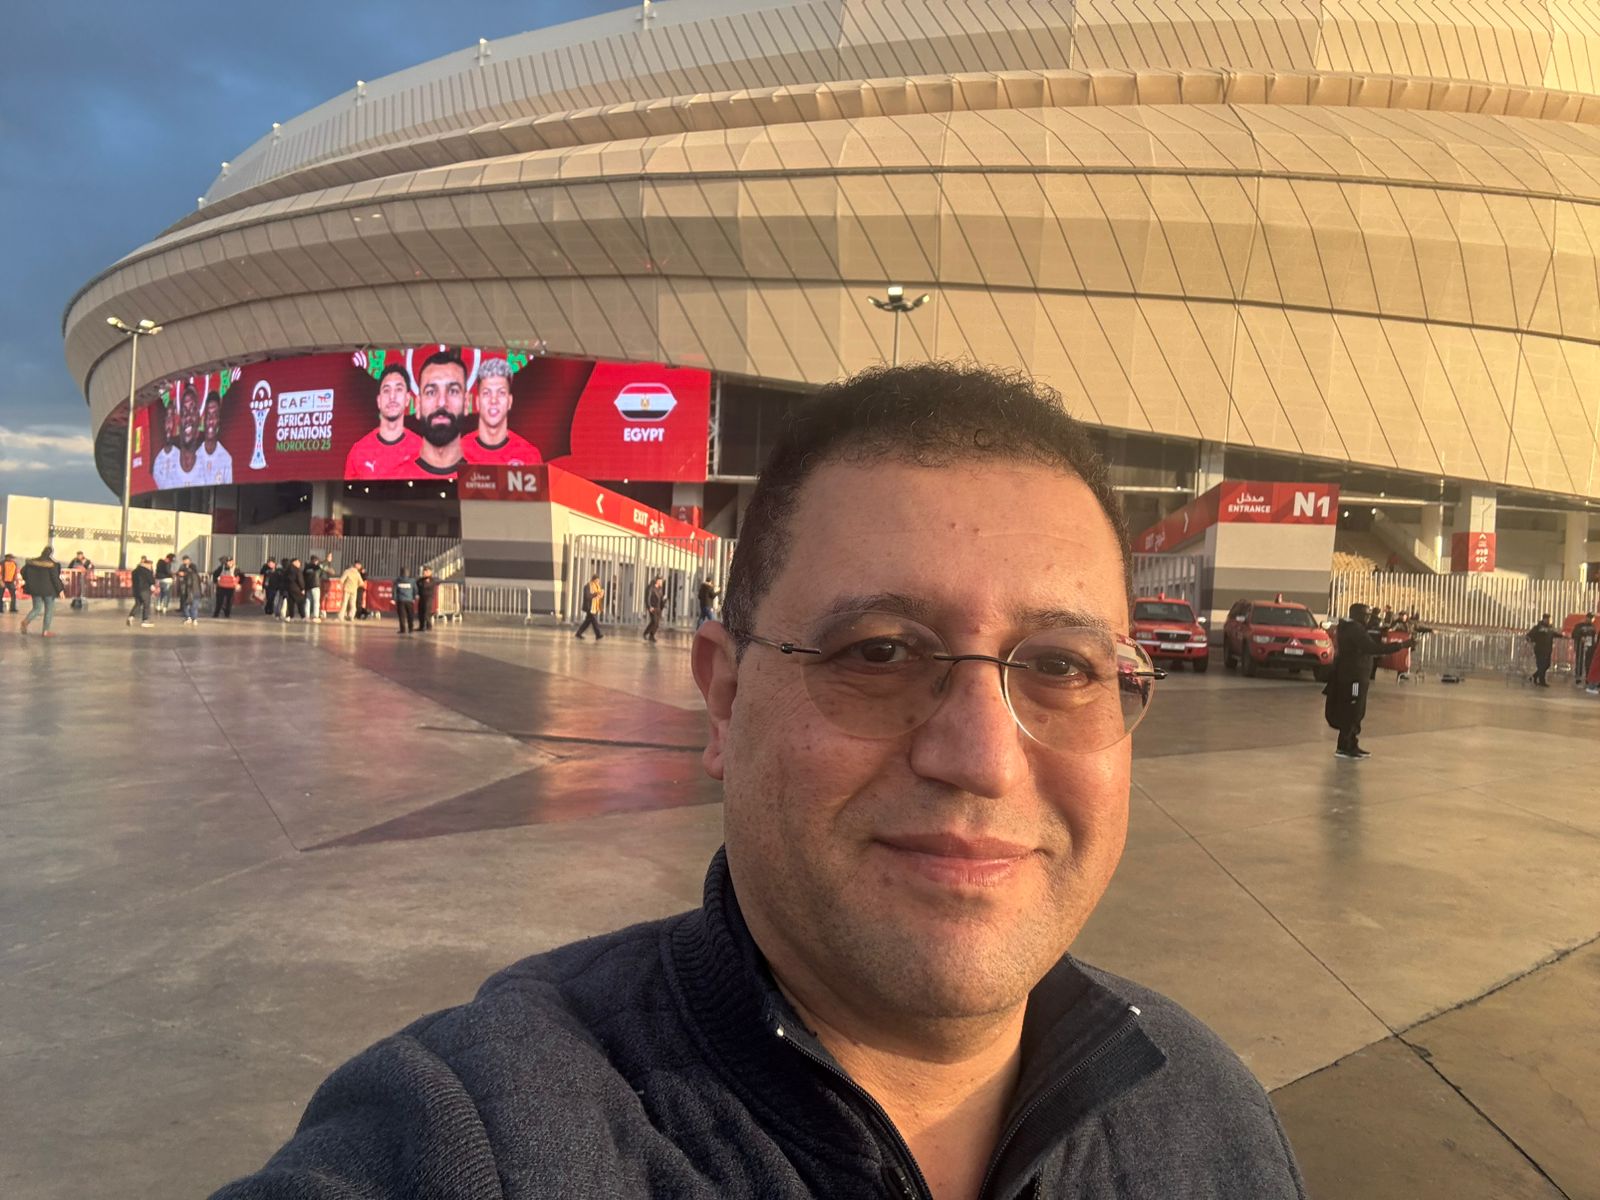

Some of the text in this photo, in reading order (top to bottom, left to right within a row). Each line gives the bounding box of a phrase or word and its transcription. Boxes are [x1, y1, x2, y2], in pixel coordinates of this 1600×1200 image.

[277, 411, 333, 427] AFRICA CUP
[276, 425, 332, 441] OF NATIONS
[623, 427, 665, 442] EGYPT
[276, 439, 331, 452] MOROCCO 25
[465, 481, 496, 489] ENTRANCE
[507, 470, 537, 492] N2
[1236, 492, 1264, 504] مدخل
[1293, 491, 1330, 517] N1
[1228, 504, 1271, 513] ENTRANCE
[633, 508, 648, 527] EXIT
